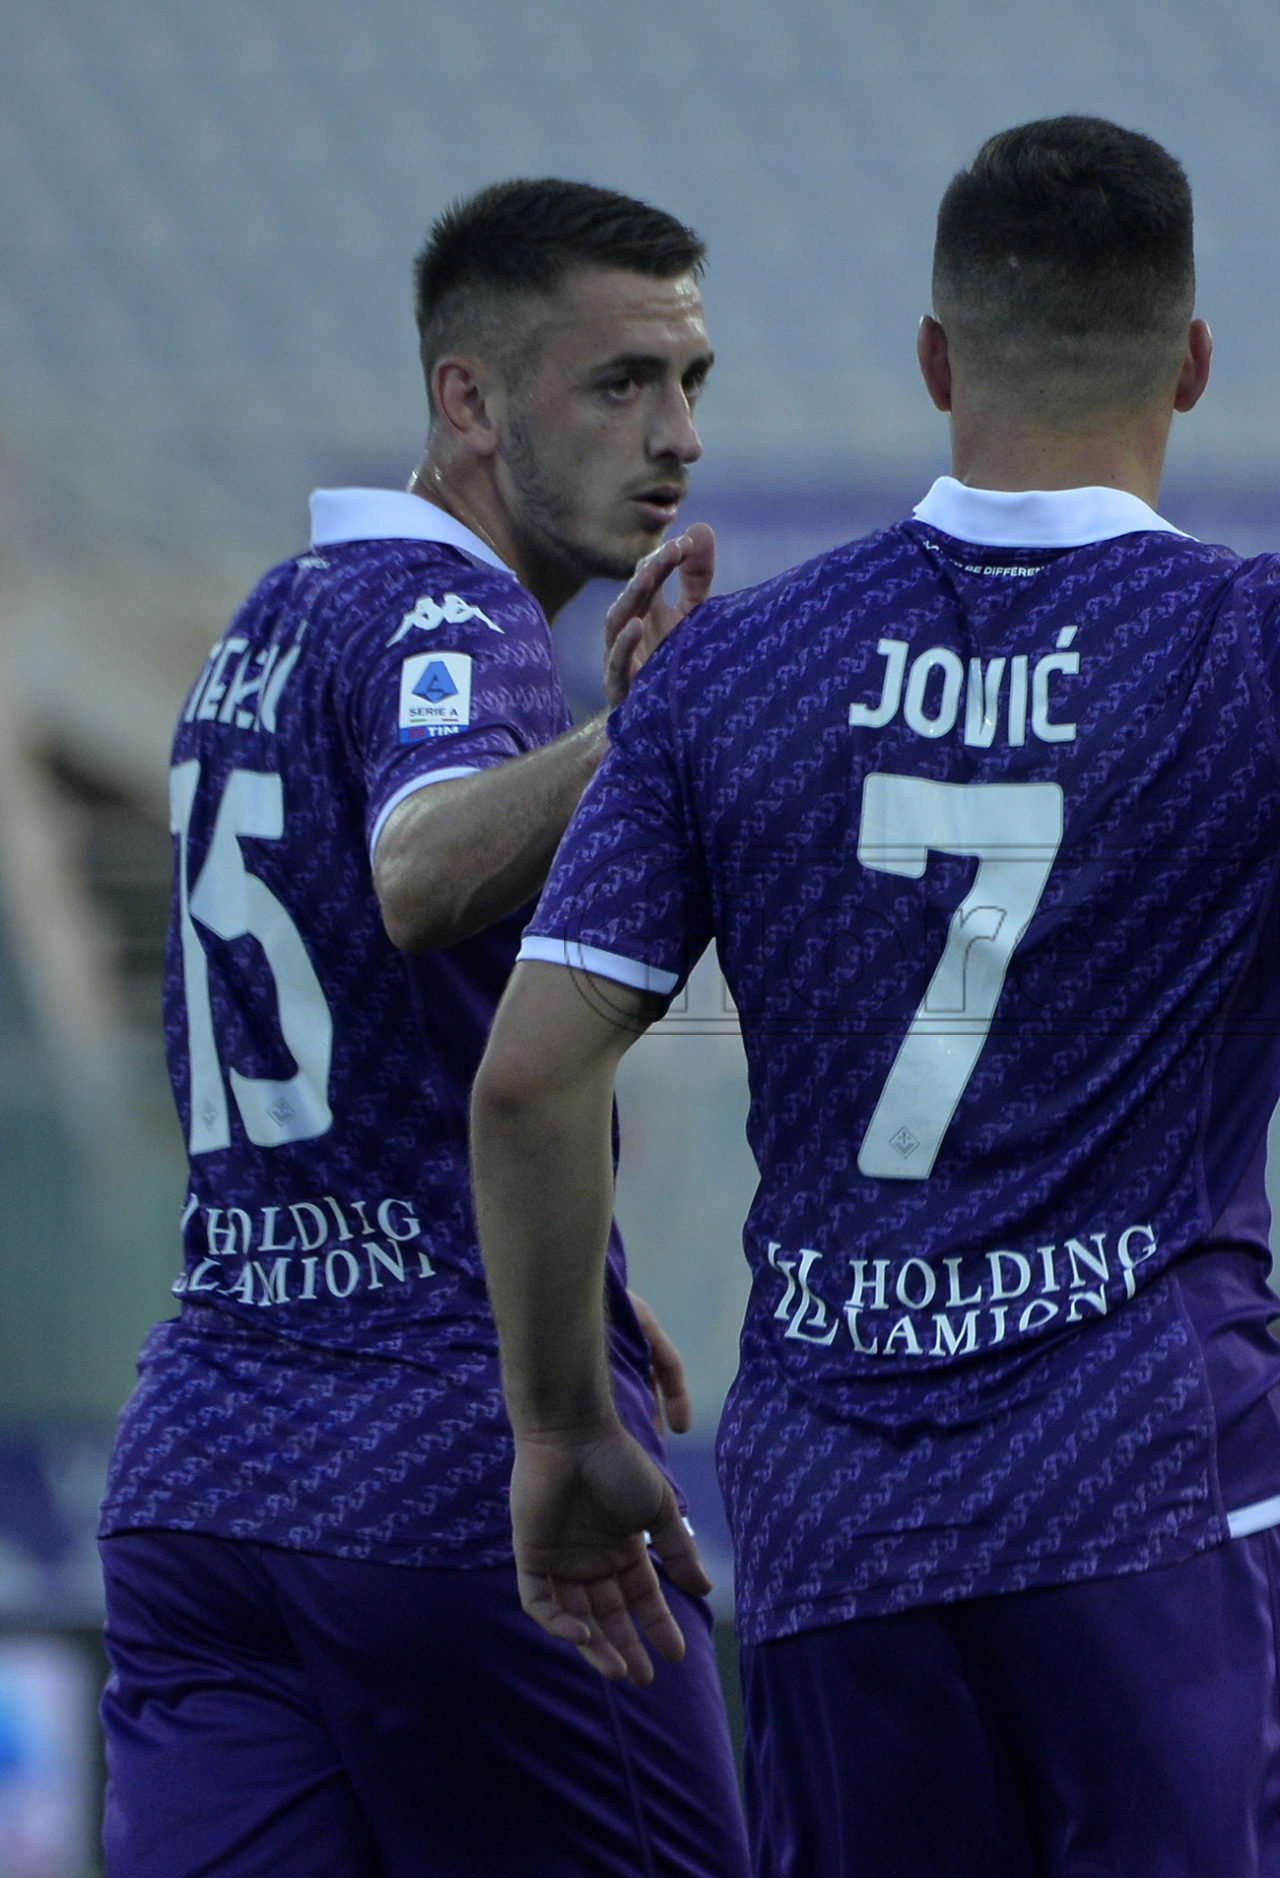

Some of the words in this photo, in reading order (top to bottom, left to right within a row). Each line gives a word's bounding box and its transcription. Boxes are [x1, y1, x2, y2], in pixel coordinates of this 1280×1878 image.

[409, 707, 447, 718] SERIE
[450, 707, 459, 717] A
[426, 725, 460, 738] TIM
[848, 625, 1081, 749] JOVIĆ
[169, 759, 333, 1155] 15
[857, 772, 1064, 1180] 7
[845, 1224, 1158, 1310] HOLDING
